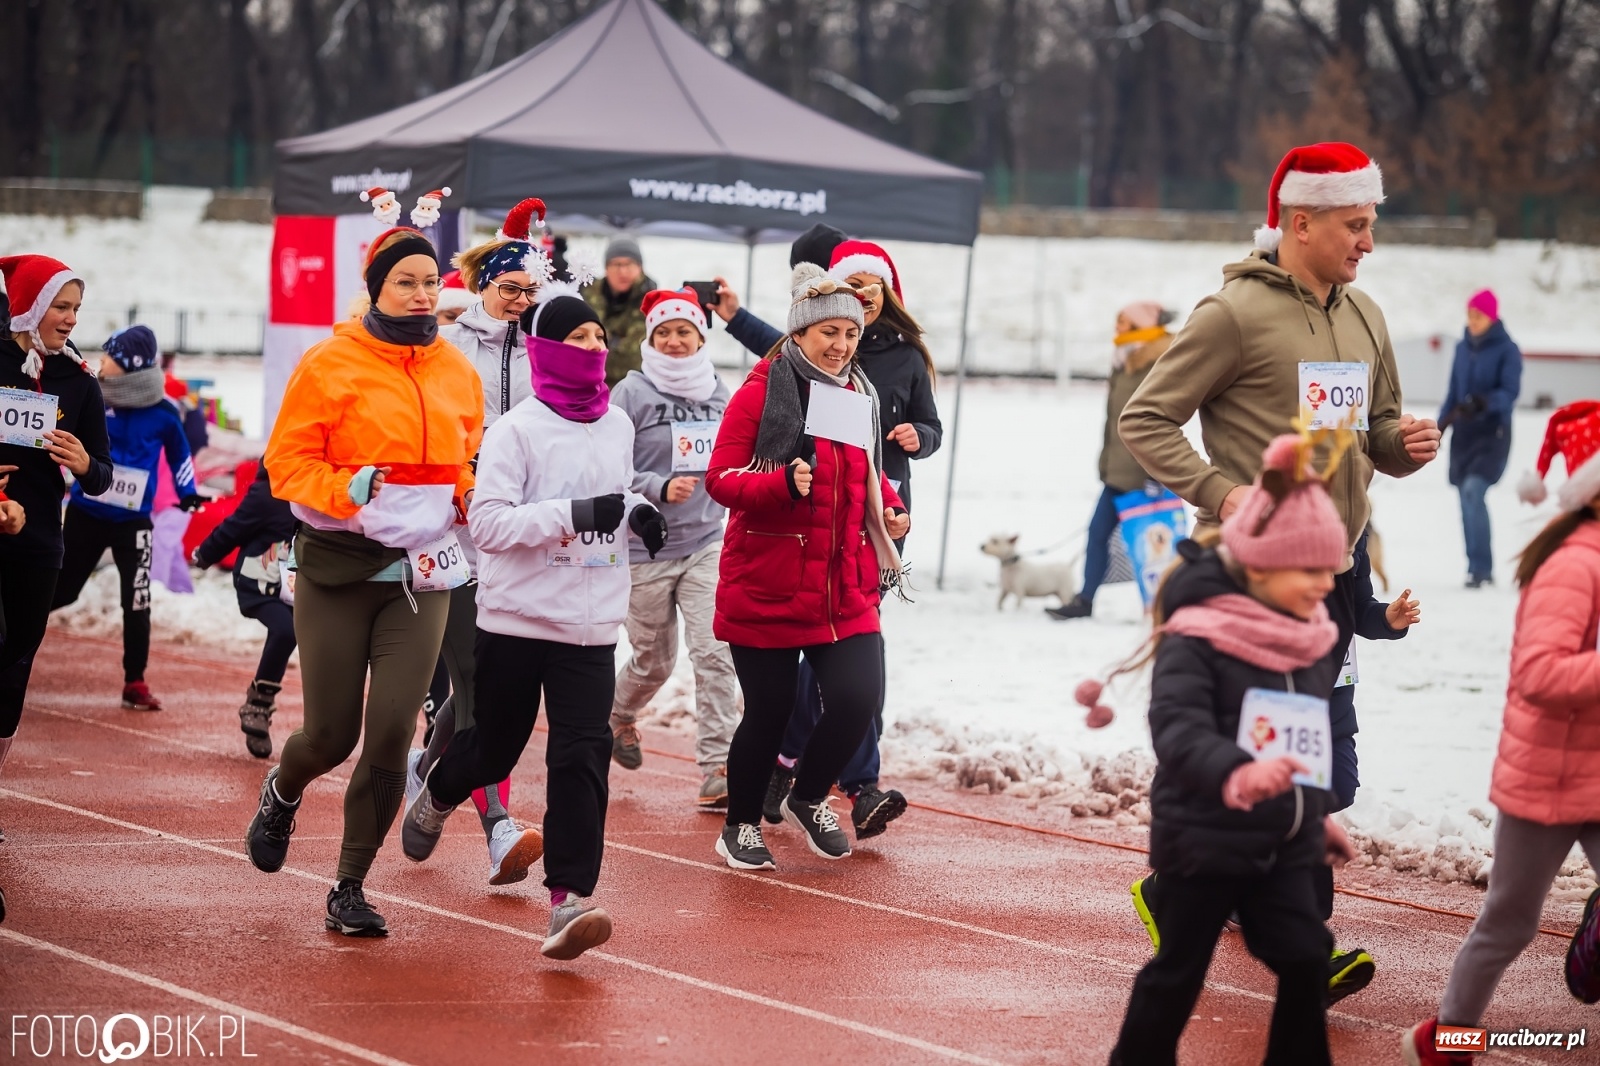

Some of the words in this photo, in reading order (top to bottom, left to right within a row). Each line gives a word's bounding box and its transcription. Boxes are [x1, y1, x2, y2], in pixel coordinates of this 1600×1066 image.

[629, 178, 826, 216] www.raciborz.pl
[1331, 386, 1363, 407] 030
[4, 408, 44, 430] 015
[695, 438, 712, 454] 01
[437, 542, 462, 570] 037
[1282, 724, 1324, 757] 185
